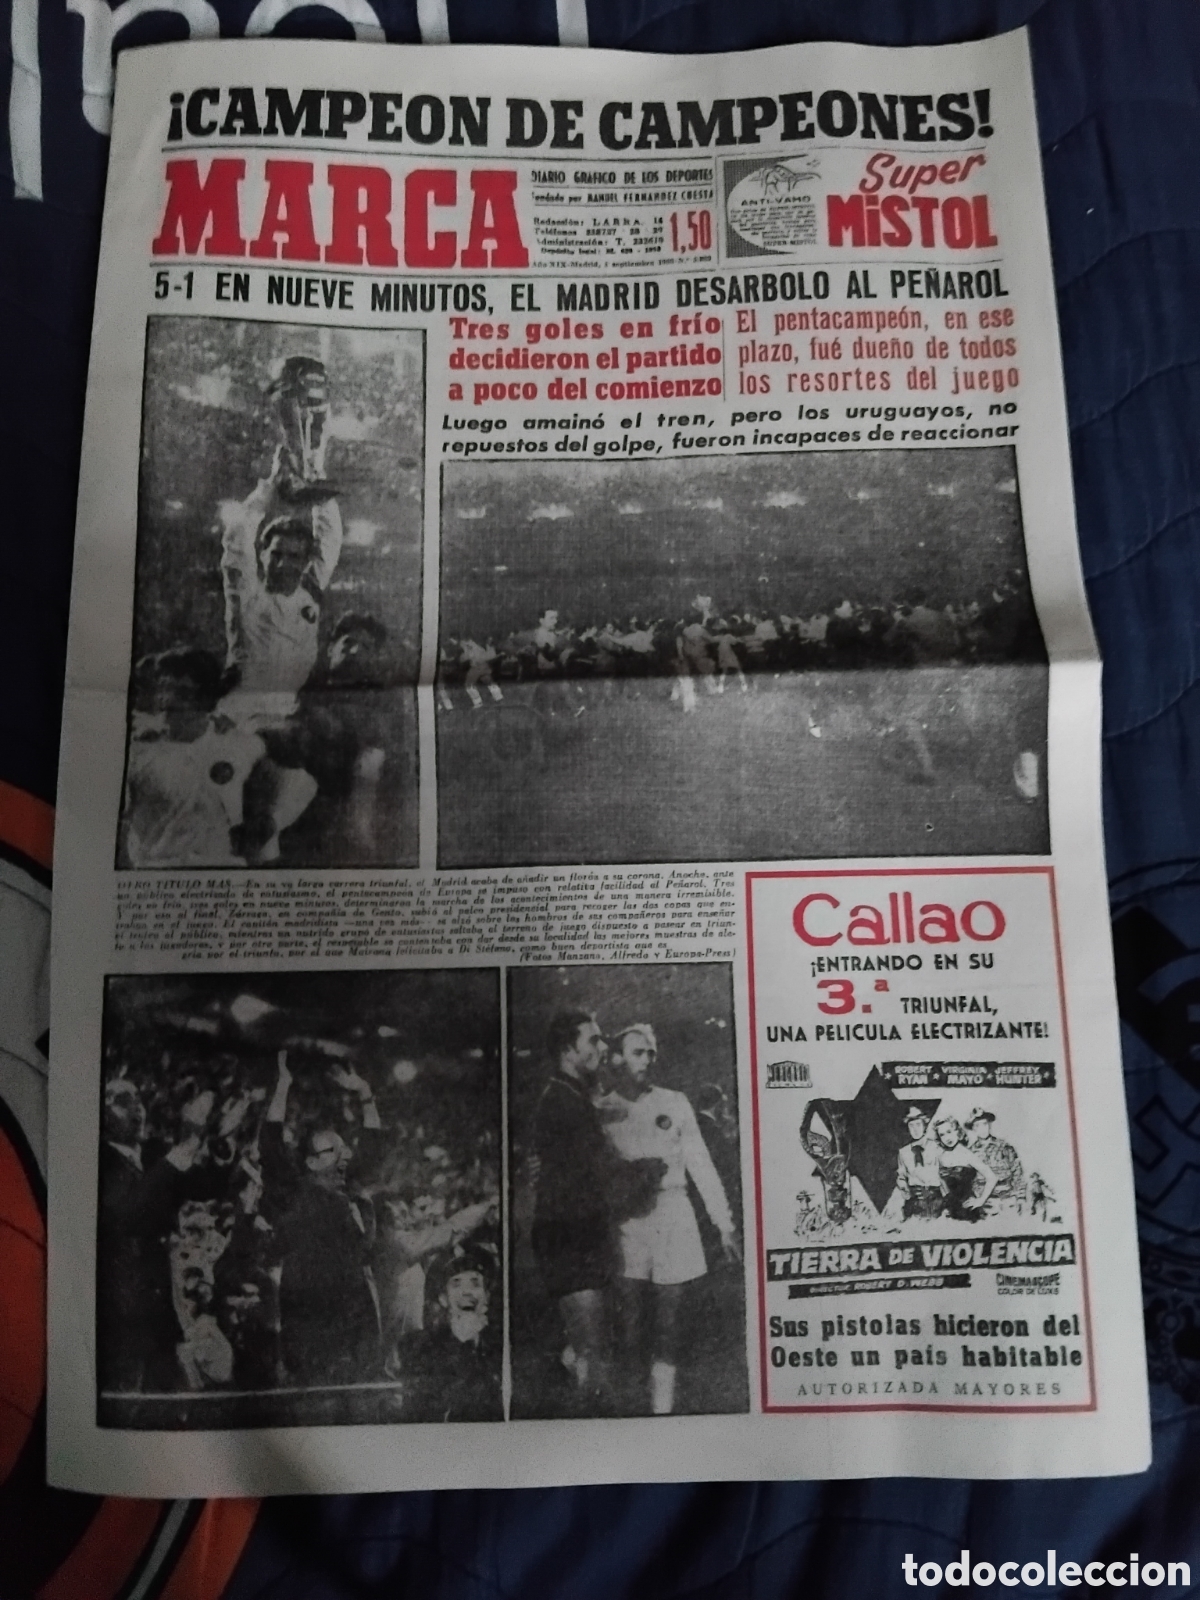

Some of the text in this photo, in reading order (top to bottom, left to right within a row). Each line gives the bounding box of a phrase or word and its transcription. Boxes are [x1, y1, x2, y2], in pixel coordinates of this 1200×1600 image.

[167, 87, 995, 151] ¡CAMPEON DE CAMPEONES!
[624, 171, 637, 184] DE
[641, 171, 659, 184] LOS
[666, 169, 713, 183] DEPORTES
[859, 153, 986, 194] Super
[153, 159, 529, 268] MARCA
[670, 210, 711, 253] 1,50
[155, 267, 1009, 316] 5-1 EN NUEVE MINUTOS, EL MADRID DESARBOLO AL PEÑAROL
[449, 313, 721, 344] Tres goles en frío
[736, 306, 1014, 336] El pentacampeón, en ese
[449, 342, 722, 374] decidieron el partido
[739, 335, 1017, 367] plazo, fué dueño de todos
[449, 376, 722, 405] a poco del comienzo
[739, 366, 1019, 395] los resortes del juego
[442, 402, 1017, 433] Luego amainó el tren, pero los uruguayos, no
[442, 423, 1020, 457] repuestos del golpe, fueron incapaces de reaccionar
[792, 891, 1006, 947] Callao
[811, 952, 994, 978] ¡ENTRANDO EN SU
[900, 995, 998, 1017] TRIUNFAL,
[766, 1021, 1049, 1043] UNA PELICULA ELECTRIZANTE!
[898, 1074, 1042, 1085] RYAN MAYO HUNTER
[770, 1239, 1073, 1277] TIERRA DE VIOLENCIA
[770, 1314, 1080, 1341] Sus pistolas hicieron del
[771, 1344, 1082, 1370] Oeste un país habitable
[798, 1381, 1061, 1396] AUTORIZADA MAYORES
